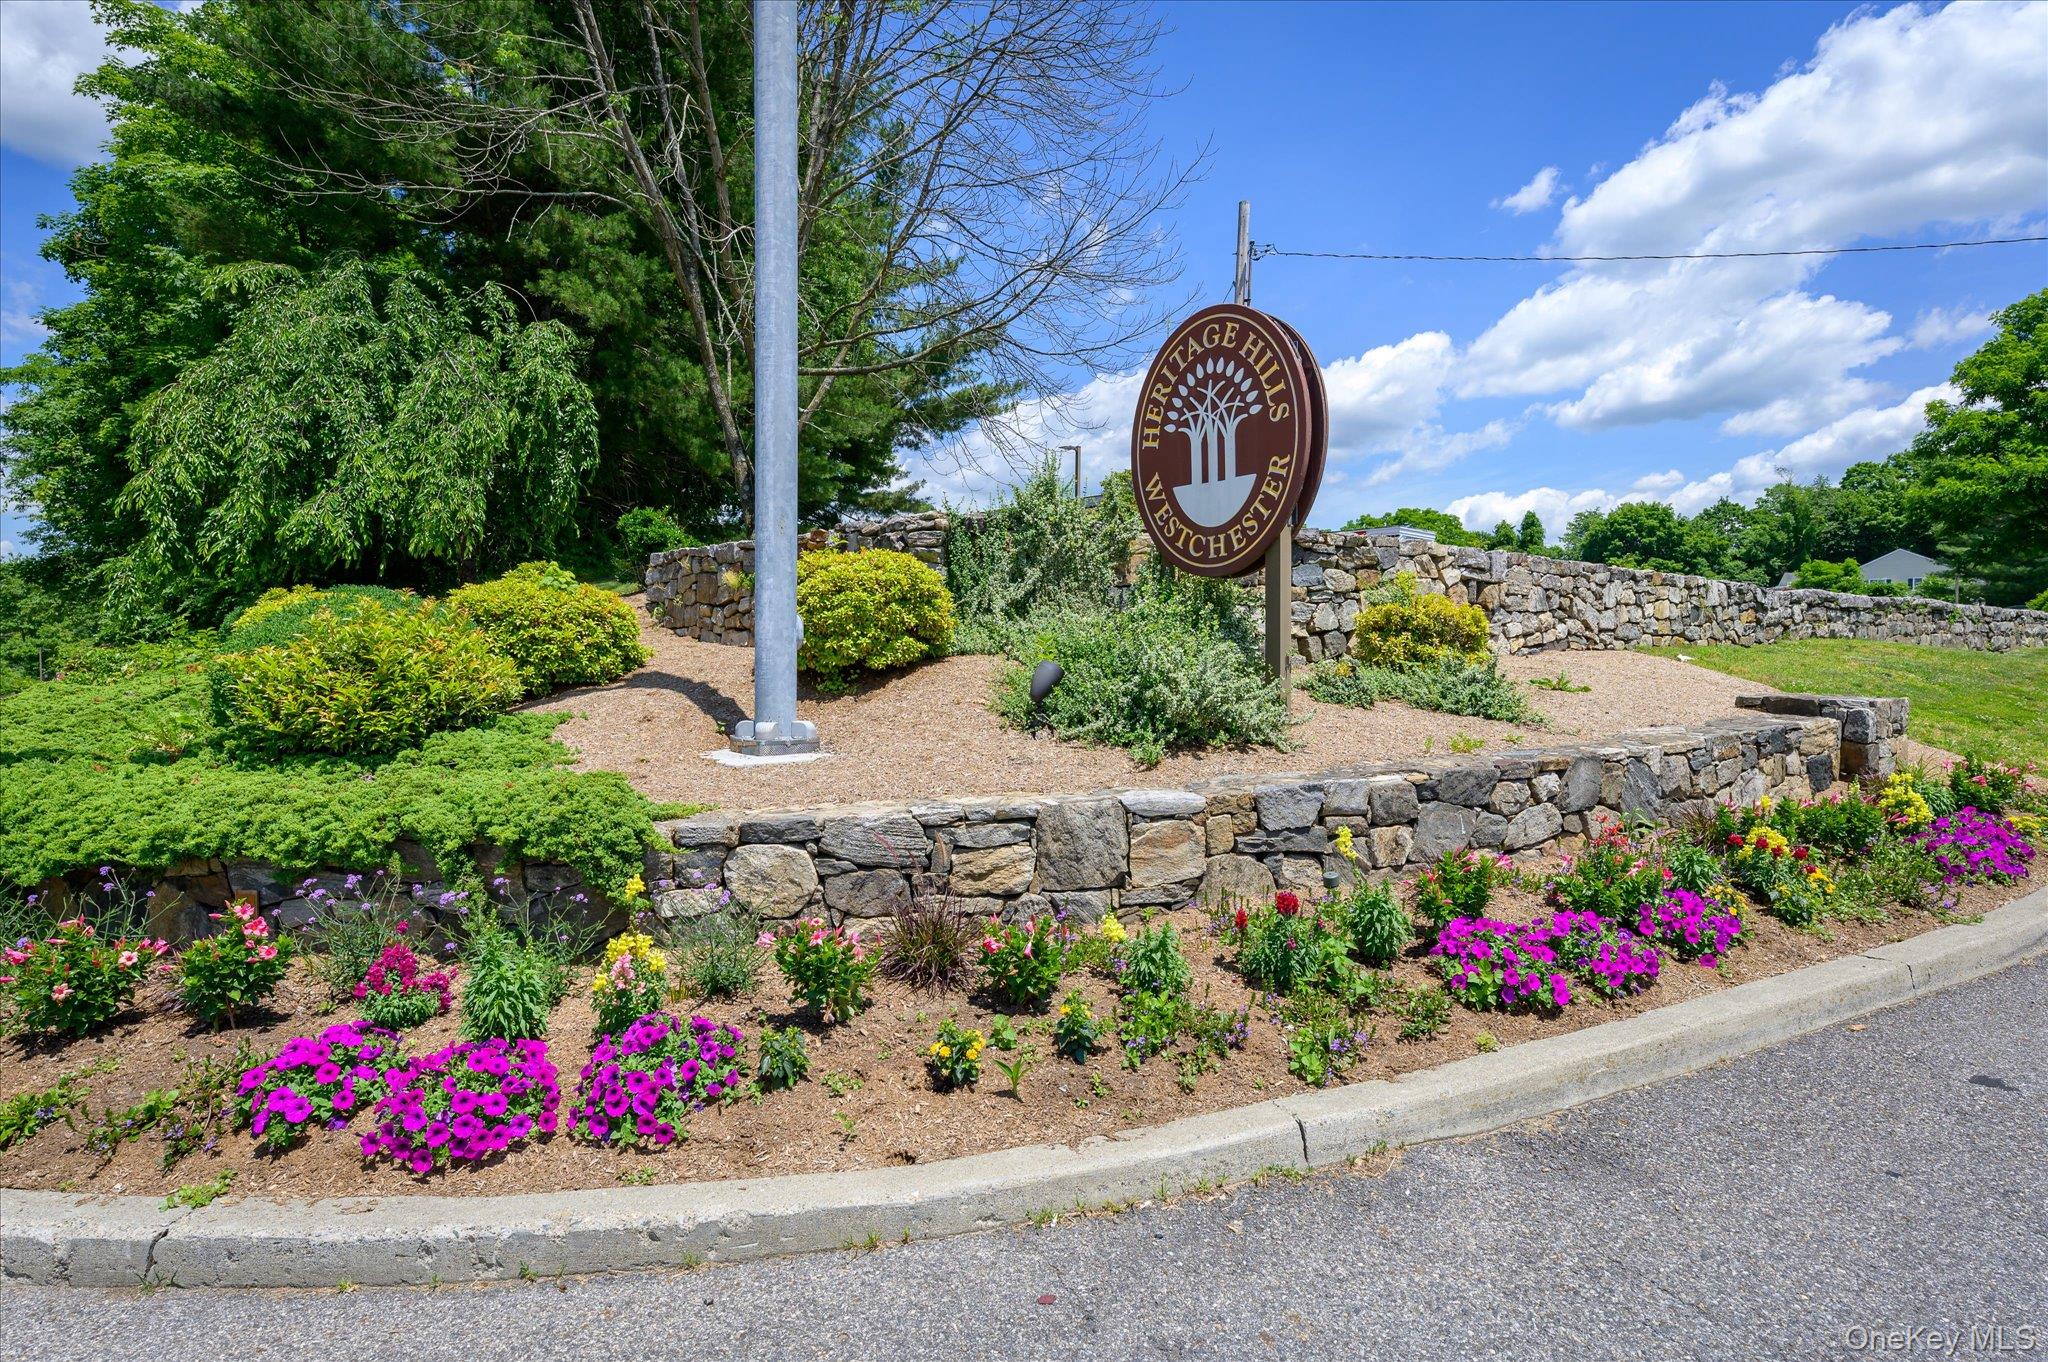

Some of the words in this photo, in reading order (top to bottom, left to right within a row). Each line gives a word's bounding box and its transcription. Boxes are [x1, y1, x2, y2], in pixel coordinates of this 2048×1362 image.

[1142, 322, 1240, 450] HERITAGE
[1238, 331, 1290, 422] HILLS
[1145, 453, 1291, 559] WESTCHESTER
